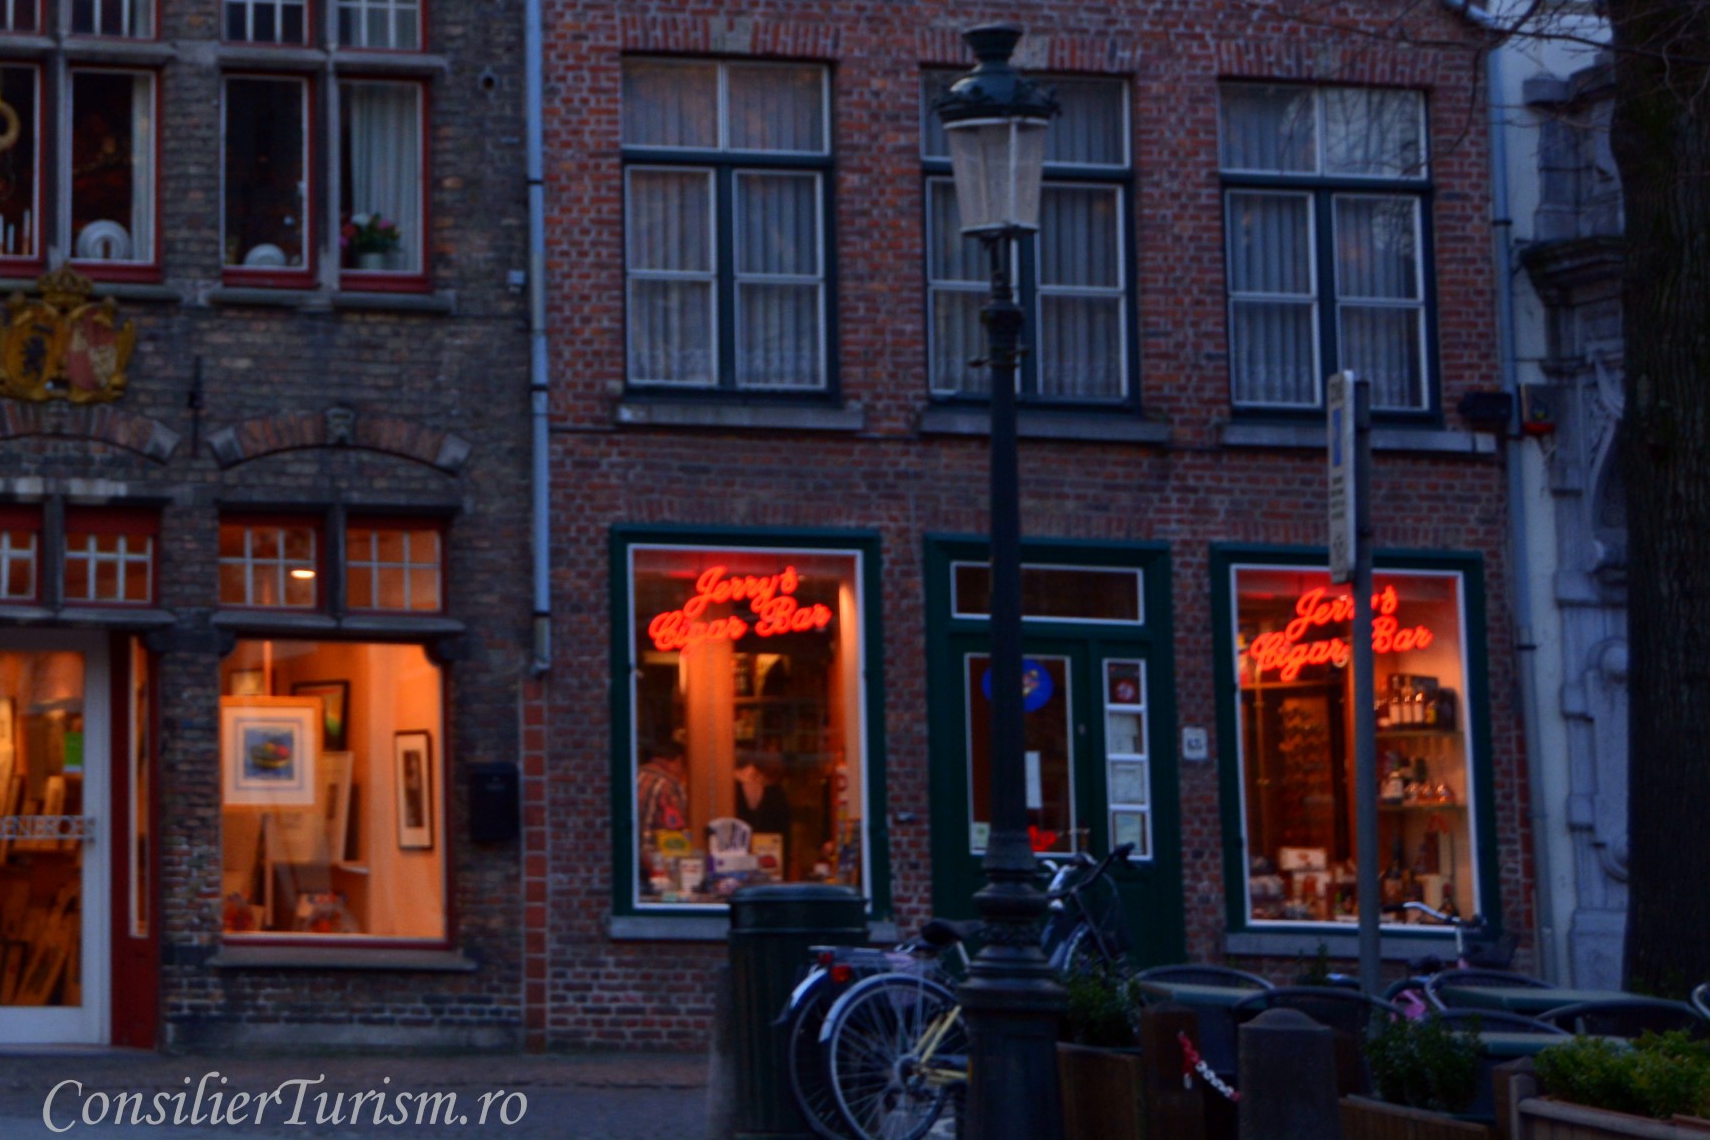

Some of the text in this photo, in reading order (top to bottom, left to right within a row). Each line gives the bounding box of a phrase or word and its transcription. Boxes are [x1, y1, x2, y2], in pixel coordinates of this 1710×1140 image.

[648, 596, 833, 656] Cigar Bar
[1285, 585, 1398, 640] Jerr's
[1250, 615, 1434, 682] Cigar Bar
